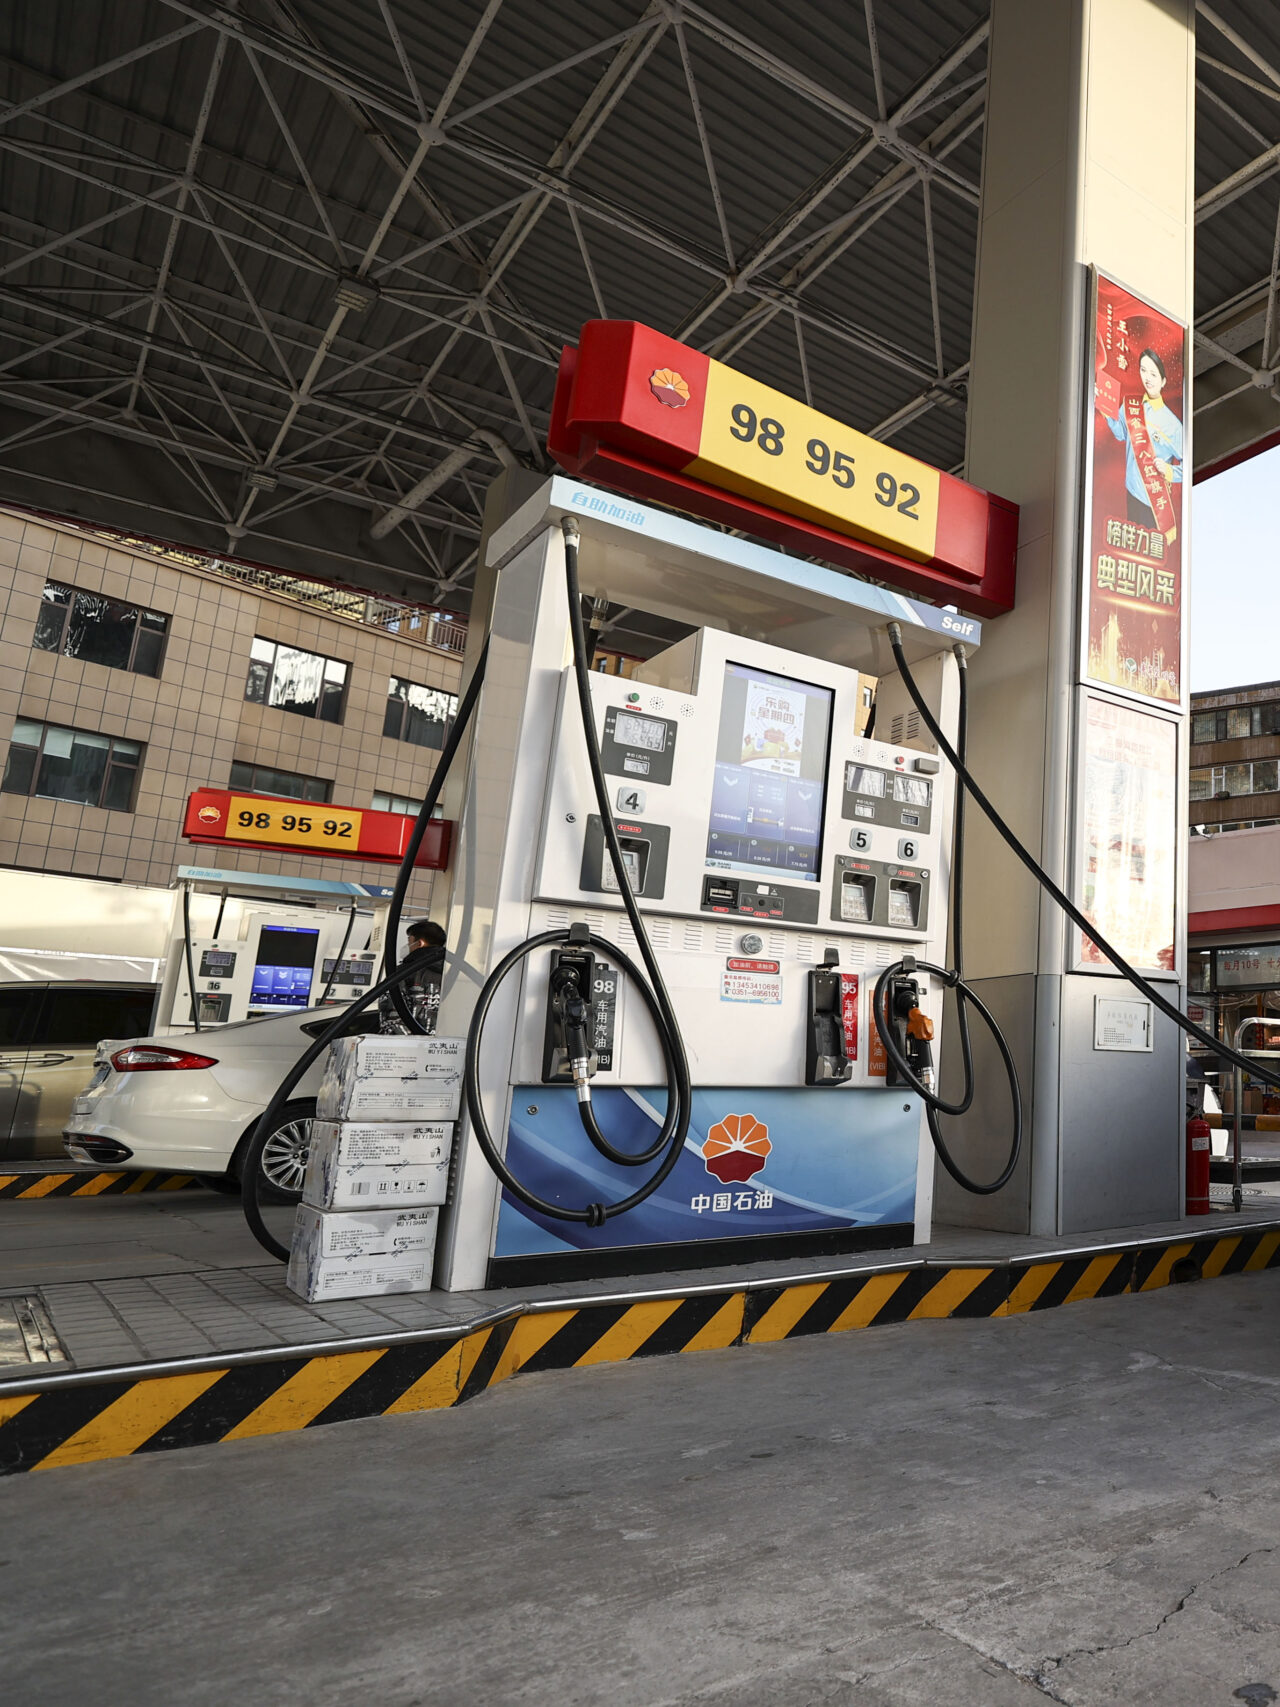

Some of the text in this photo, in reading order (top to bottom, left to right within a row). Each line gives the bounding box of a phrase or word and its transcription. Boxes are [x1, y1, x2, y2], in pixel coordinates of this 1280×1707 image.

[729, 403, 921, 521] 98 95 92
[571, 491, 646, 526] 自助加油
[1106, 519, 1165, 560] 榜样力量
[1096, 554, 1175, 606] 典型风采
[941, 616, 974, 636] Self
[625, 792, 639, 810] 4
[237, 811, 353, 838] 98 95 92
[856, 831, 867, 848] 5
[904, 842, 914, 857] 6
[208, 981, 220, 990] 16
[352, 988, 363, 997] 18
[593, 980, 614, 994] 98
[841, 982, 857, 994] 95
[594, 1000, 609, 1048] 车用汽油
[428, 1042, 458, 1050] 武夷山
[690, 1189, 774, 1214] 中国石油
[396, 1213, 428, 1221] 武夷山
